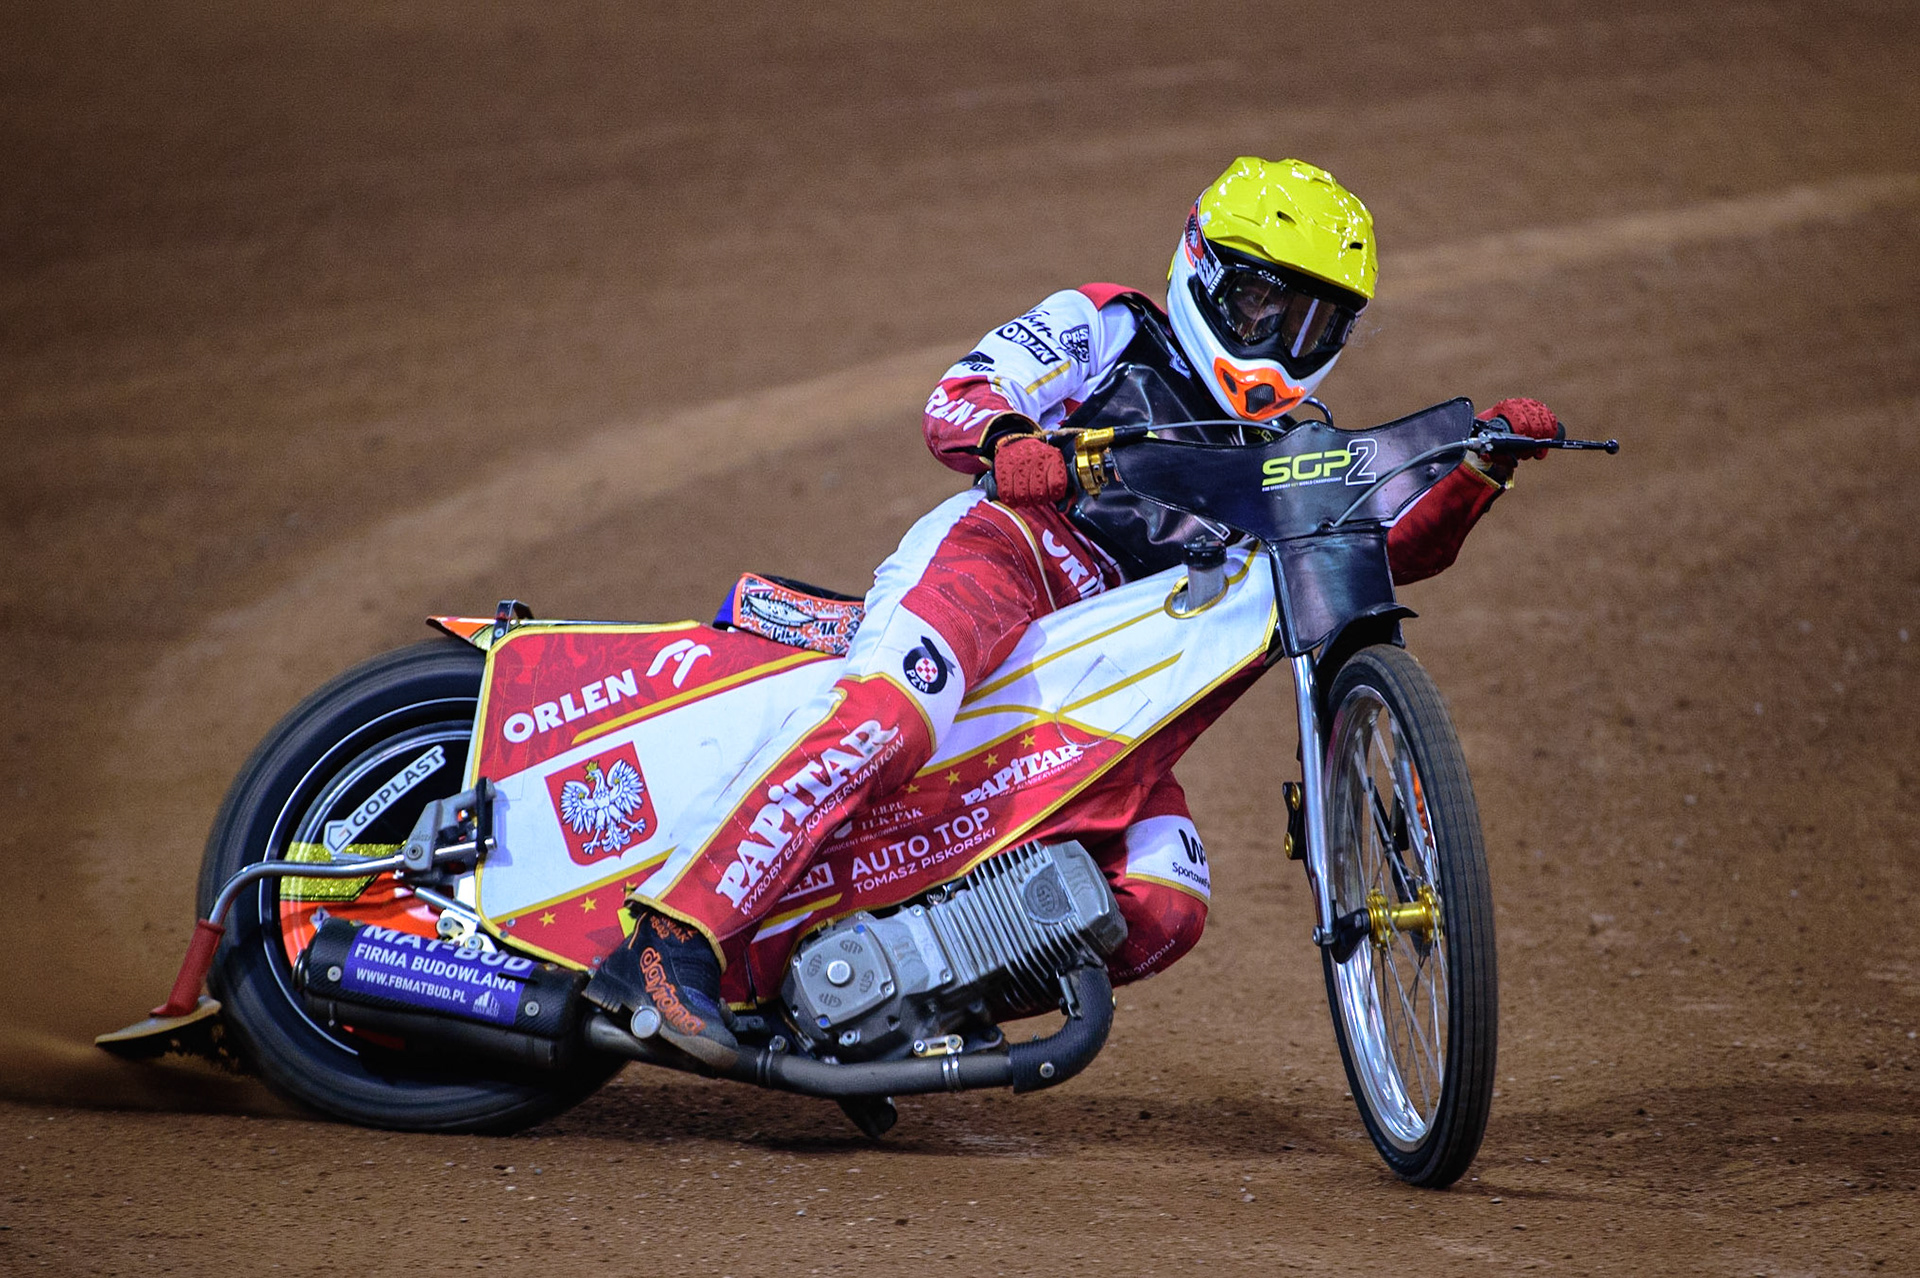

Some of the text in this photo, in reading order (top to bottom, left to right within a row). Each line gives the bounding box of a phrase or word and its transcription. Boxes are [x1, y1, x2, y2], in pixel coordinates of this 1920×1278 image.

[1001, 322, 1057, 364] ORLEN
[503, 668, 639, 744] ORLEN
[906, 669, 929, 692] PZM
[352, 749, 441, 827] GOPLAST
[740, 858, 783, 916] WYROBY
[784, 829, 805, 861] BEZ
[851, 834, 931, 881] AUTO
[933, 806, 991, 846] TOP
[853, 826, 997, 895] TOMASZ PISKORSKI
[354, 943, 517, 992] FIRMA BUDOWLANA
[356, 967, 467, 1005] WWW.FBMATBUD.PL
[640, 947, 707, 1036] daytona
